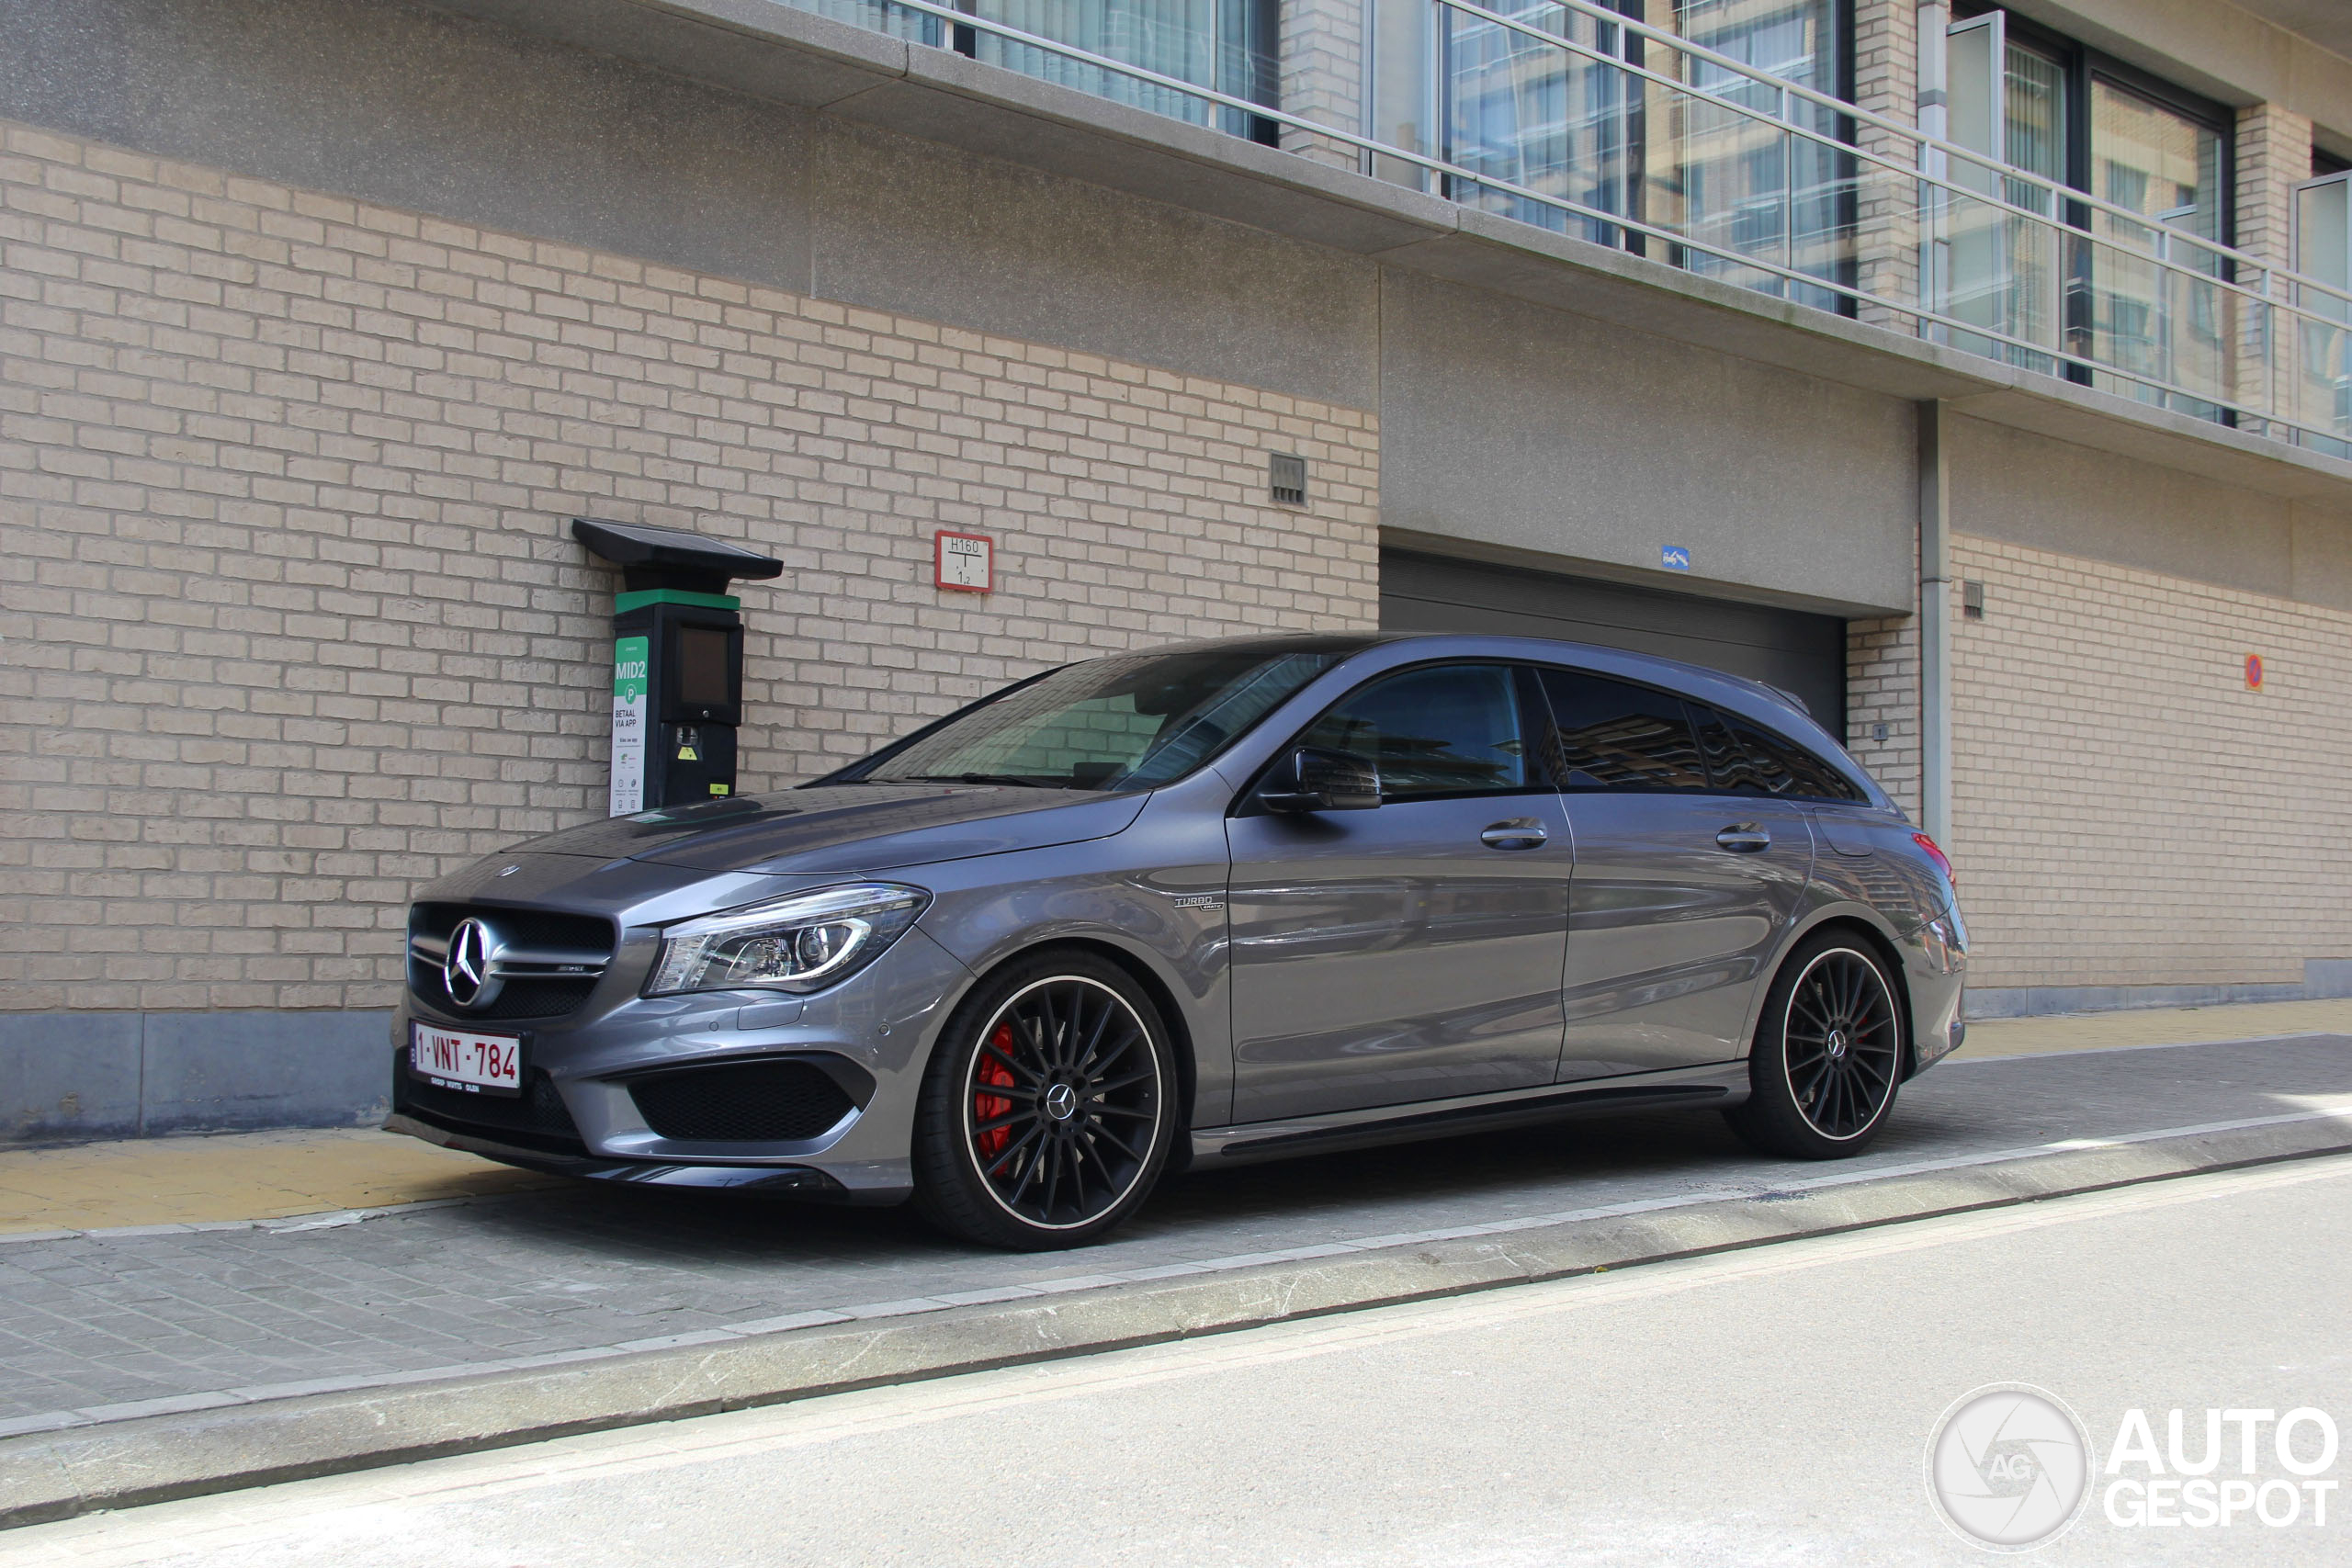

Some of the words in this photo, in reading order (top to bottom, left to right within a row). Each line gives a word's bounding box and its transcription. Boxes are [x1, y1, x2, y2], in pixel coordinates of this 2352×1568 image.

[951, 538, 979, 553] H160
[616, 661, 646, 680] MID2
[615, 709, 636, 718] BETAAL
[615, 720, 624, 728] VIA
[625, 719, 637, 728] APP
[1175, 897, 1213, 906] TURBO
[418, 1031, 515, 1080] 1-VNT-784
